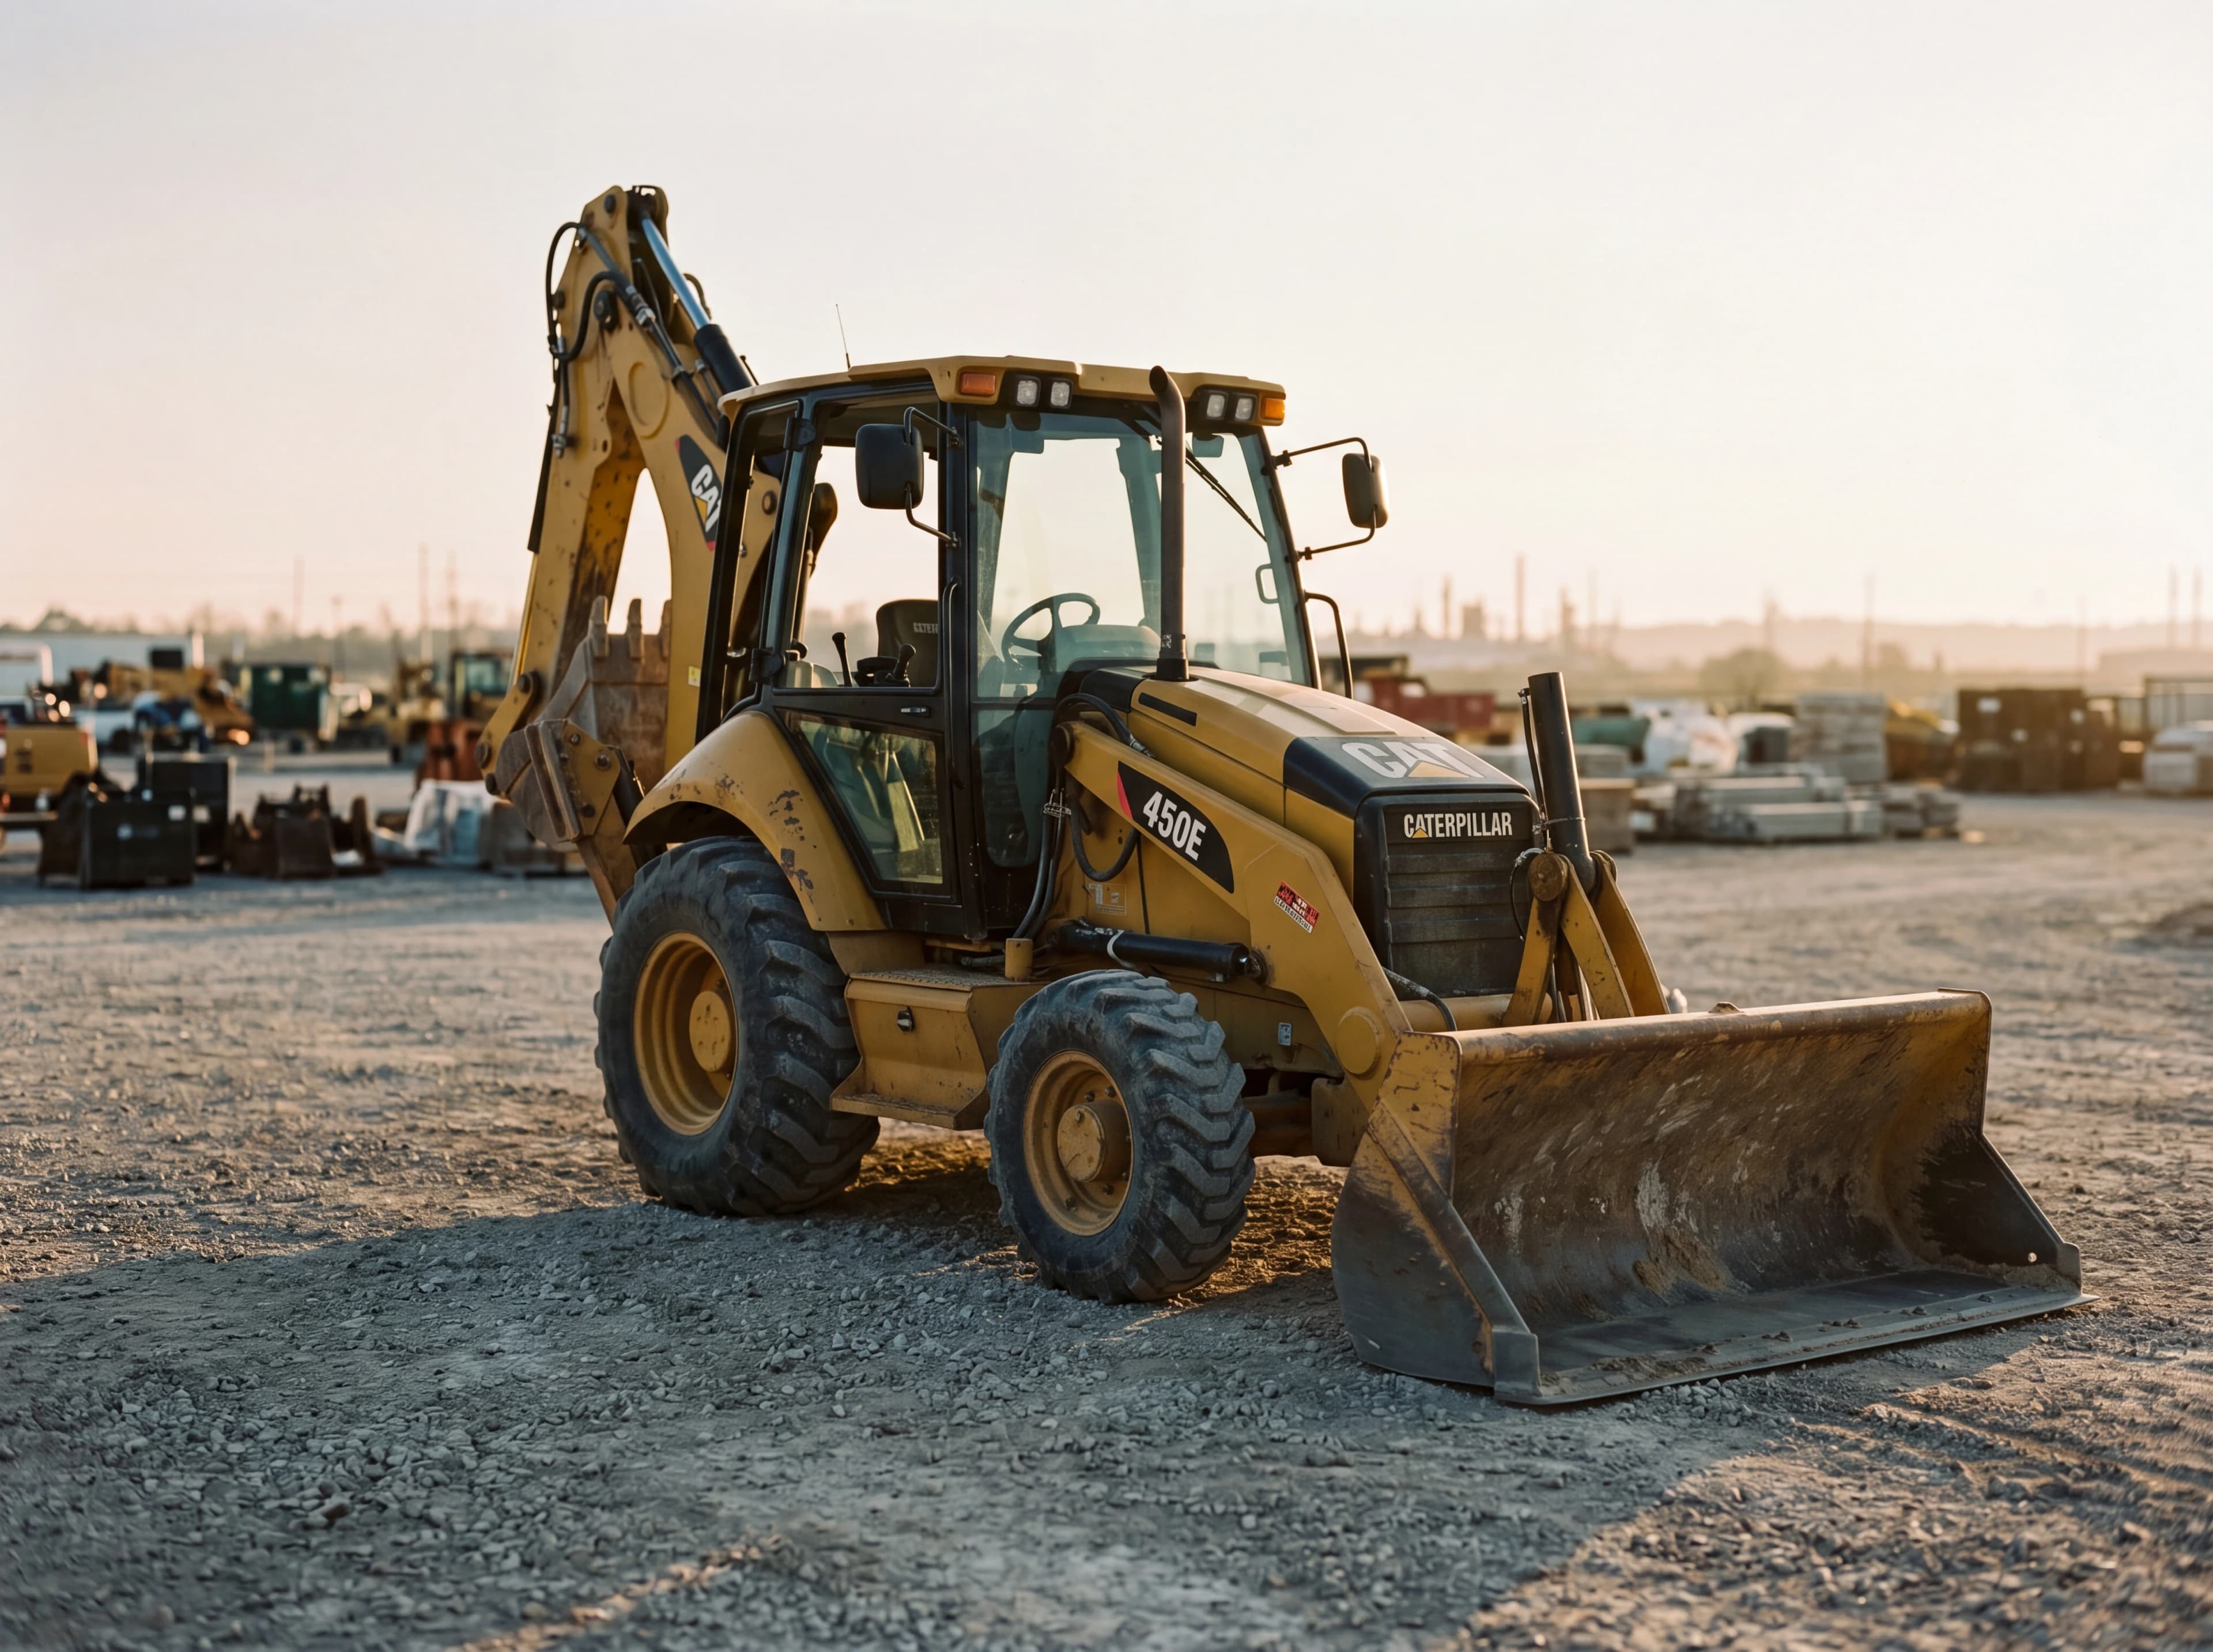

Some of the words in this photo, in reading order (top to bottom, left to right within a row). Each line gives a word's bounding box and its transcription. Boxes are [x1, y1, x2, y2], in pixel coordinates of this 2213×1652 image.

[1342, 742, 1485, 778] CAT
[1143, 791, 1206, 861] 450E
[1404, 812, 1513, 838] CATERPILLAR
